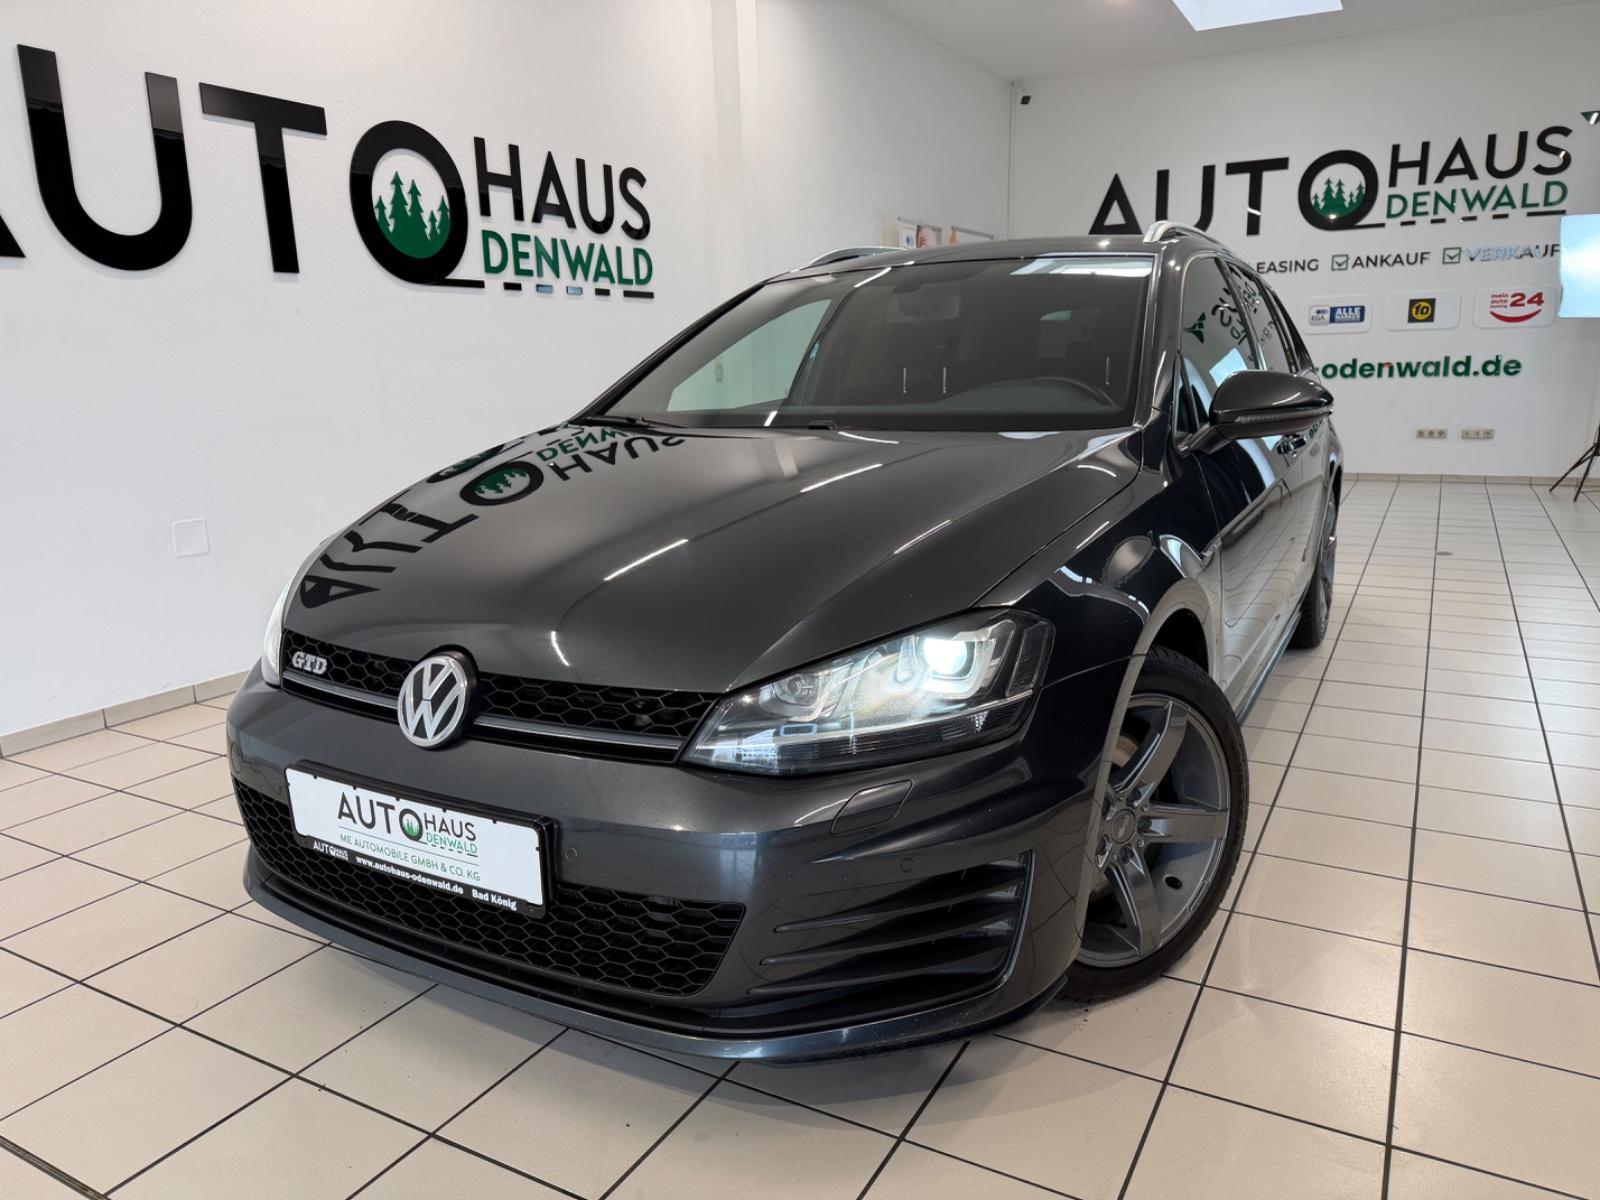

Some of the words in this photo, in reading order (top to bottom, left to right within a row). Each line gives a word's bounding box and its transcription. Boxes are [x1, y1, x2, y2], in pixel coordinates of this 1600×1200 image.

[0, 44, 468, 284] UTO
[1386, 181, 1568, 219] DENWALD
[481, 230, 653, 286] DENWALD
[1256, 258, 1319, 275] EASING
[1352, 252, 1431, 269] ANKAUF
[1510, 291, 1545, 307] 24
[291, 650, 327, 675] GTD
[340, 834, 352, 845] ME
[354, 838, 410, 862] AUTOMOBILE
[411, 855, 440, 871] GMBH
[441, 863, 448, 873] &
[466, 868, 480, 881] KG
[426, 832, 477, 855] DENWALD
[355, 856, 464, 895] www.autohaus-odenwald.de
[472, 888, 490, 903] Bad
[490, 893, 518, 912] König
